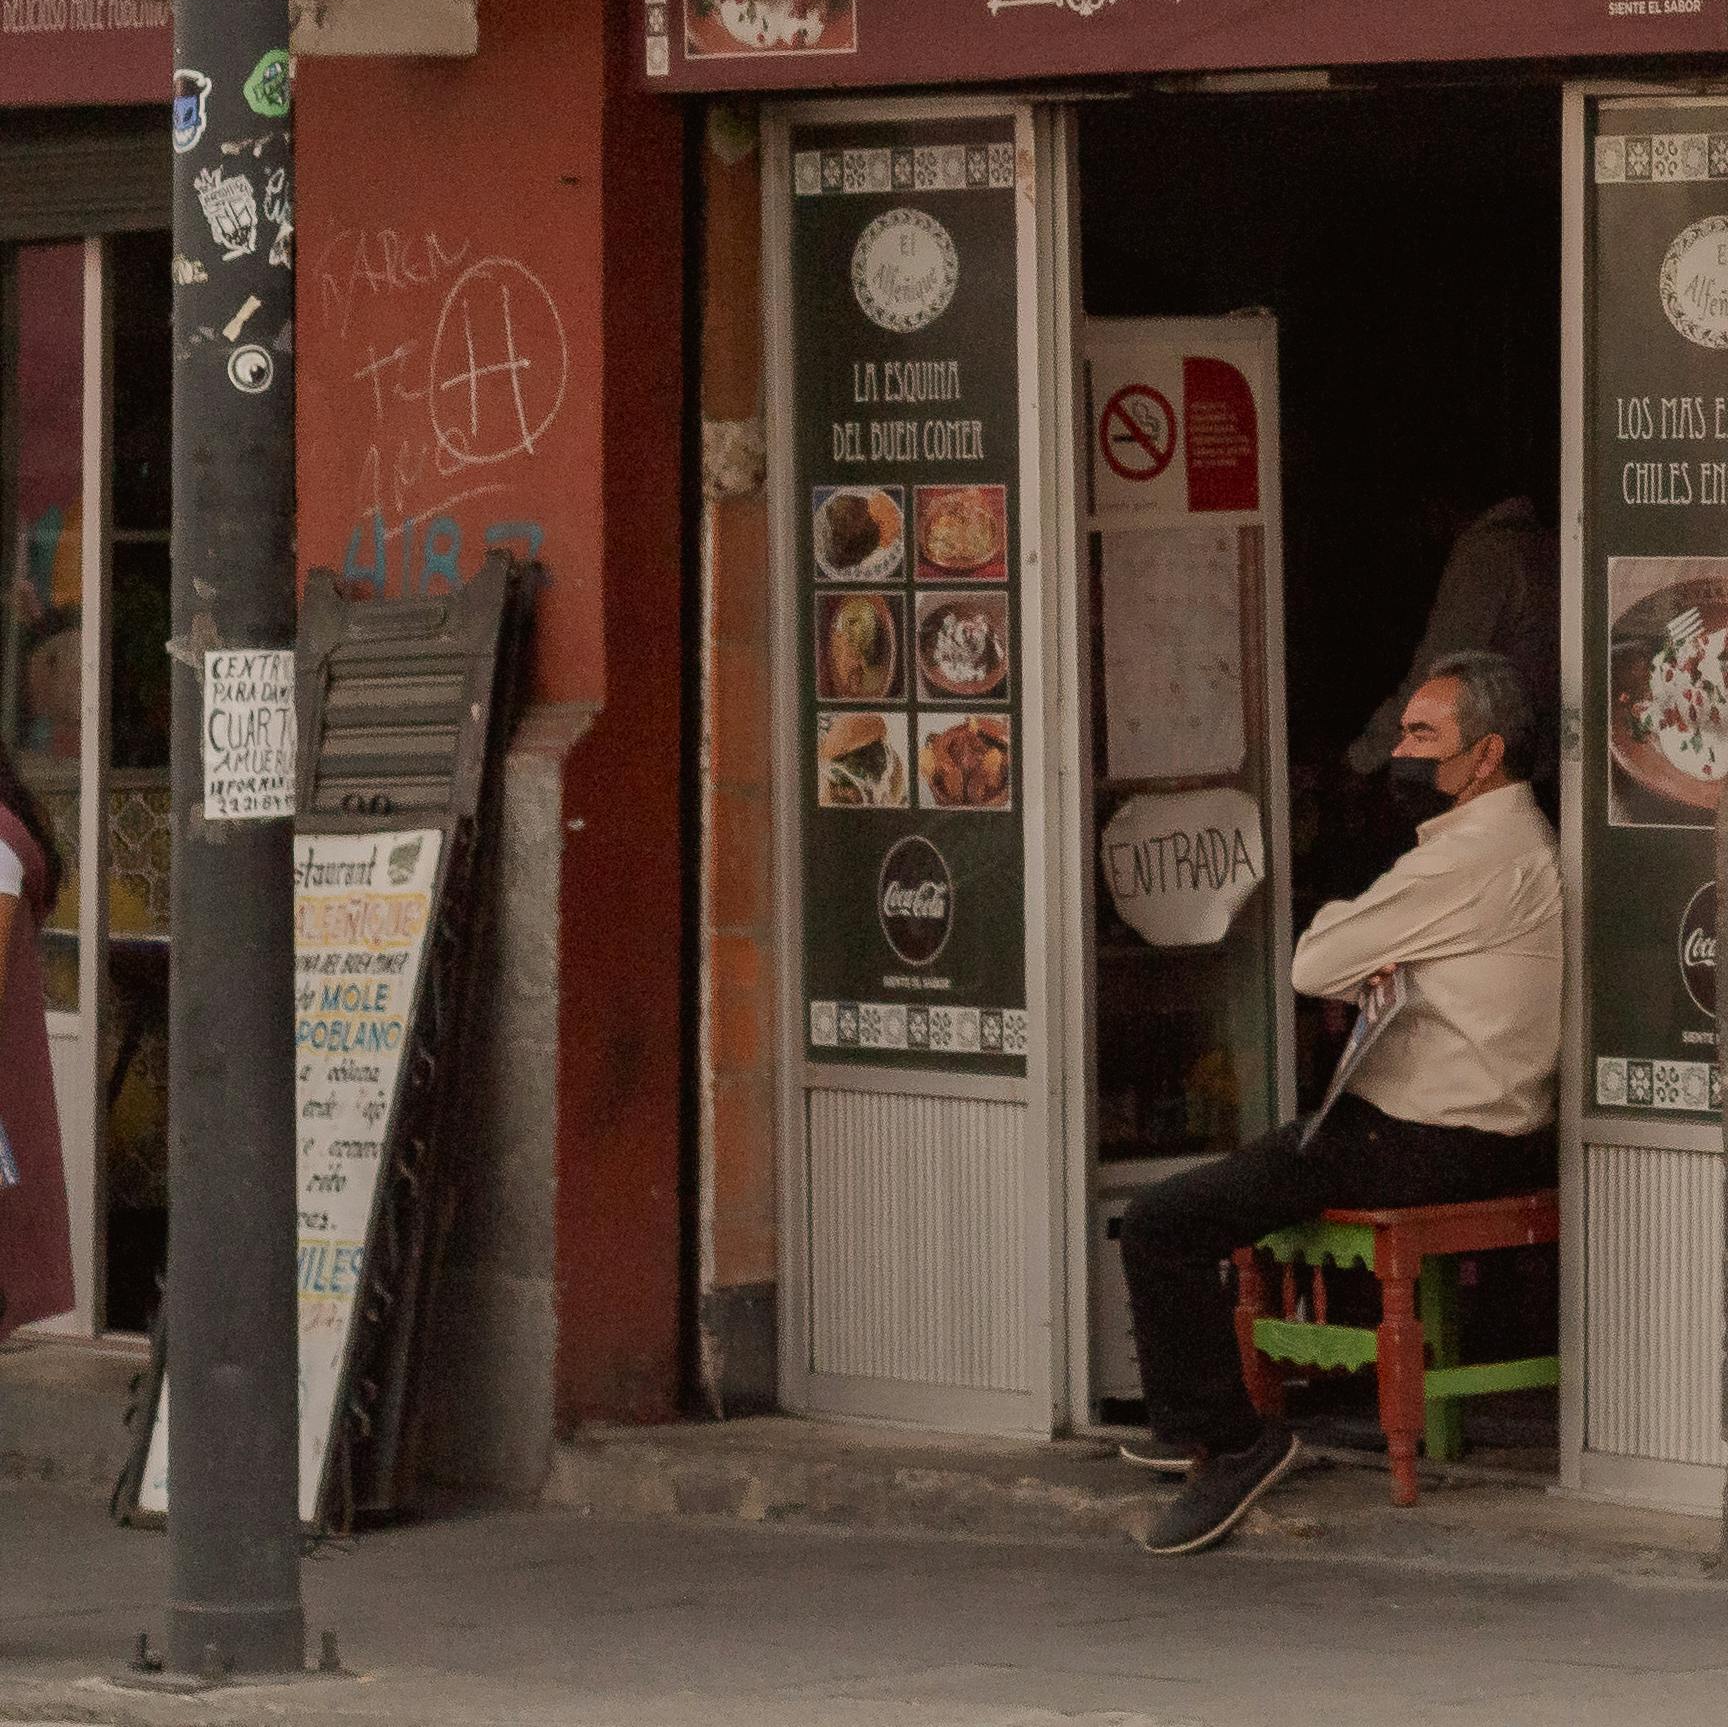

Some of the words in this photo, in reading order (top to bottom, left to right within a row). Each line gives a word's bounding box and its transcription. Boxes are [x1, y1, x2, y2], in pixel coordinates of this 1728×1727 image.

[1608, 0, 1646, 15] SIENTE
[1648, 0, 1662, 14] EL
[1664, 0, 1702, 14] SABOR
[854, 361, 877, 403] LA
[884, 360, 961, 401] ESQUINA
[1616, 397, 1652, 439] LOS
[1662, 398, 1706, 438] MAS
[832, 422, 866, 462] DEL
[871, 421, 918, 461] BUEN
[923, 420, 984, 460] COMER
[1623, 463, 1693, 505] CHILES
[1700, 463, 1725, 504] EN
[1108, 828, 1256, 900] ENTRADA
[321, 984, 389, 1012] MOLE
[296, 1020, 401, 1052] POBLANO
